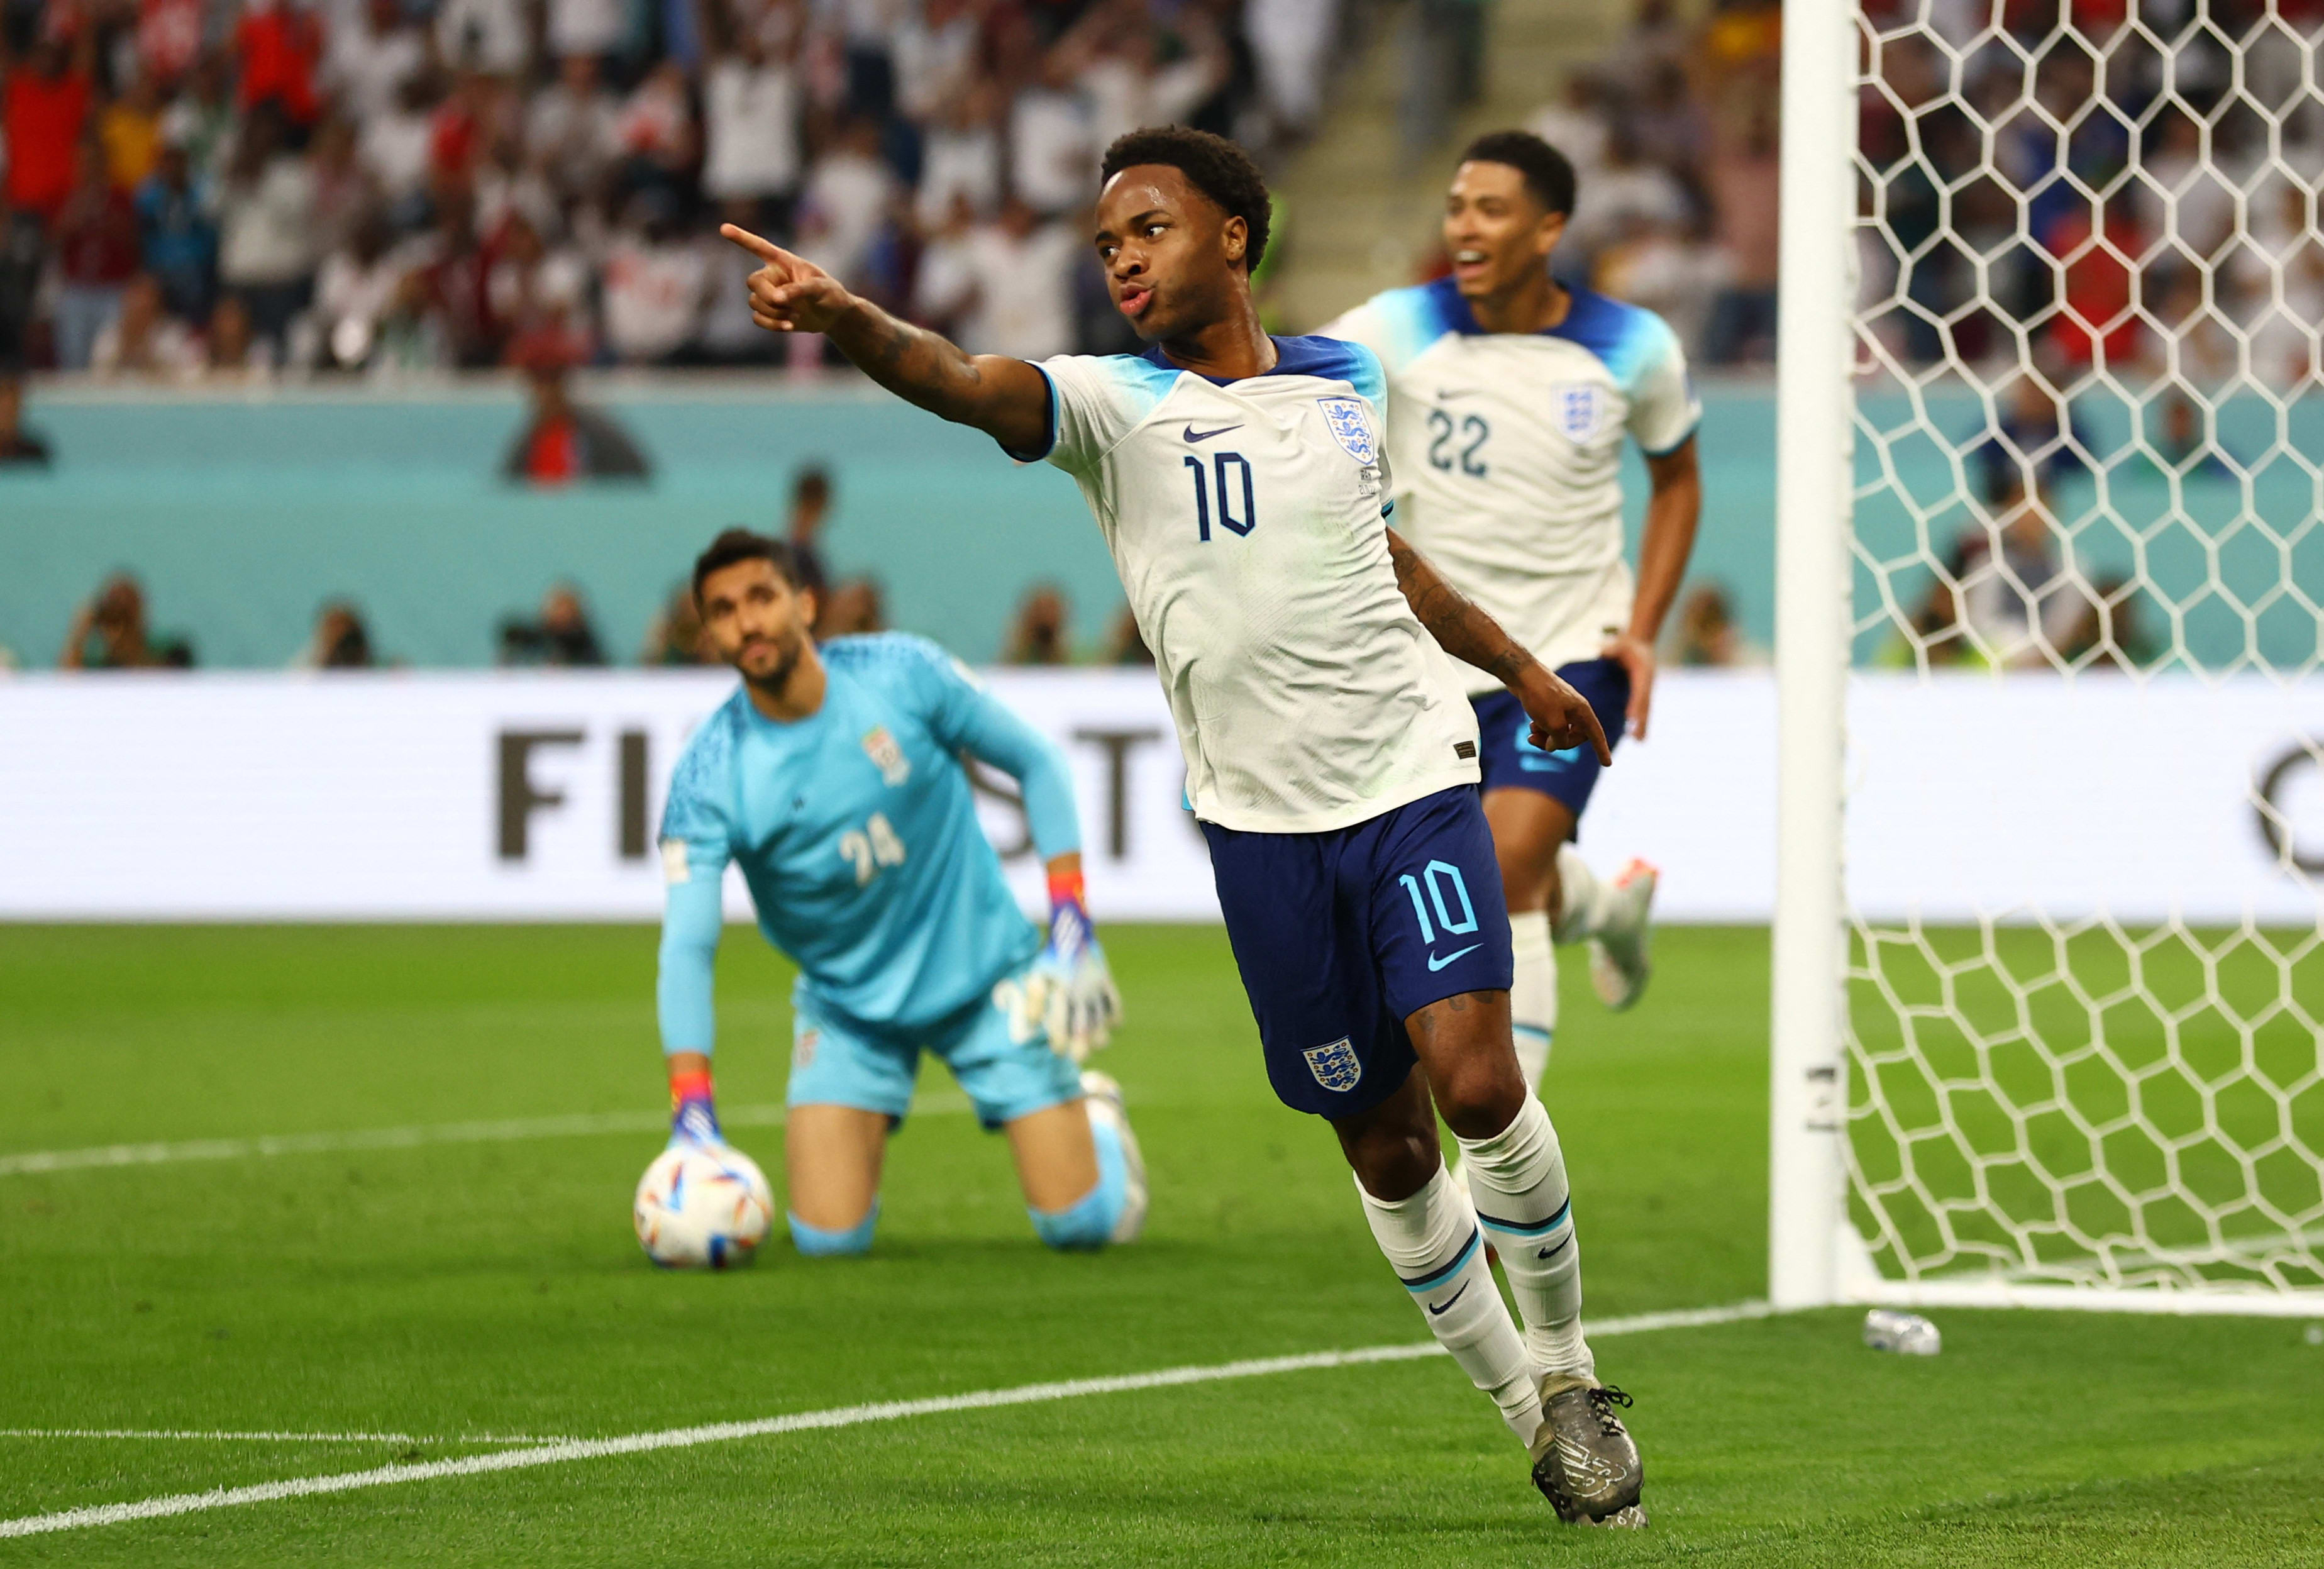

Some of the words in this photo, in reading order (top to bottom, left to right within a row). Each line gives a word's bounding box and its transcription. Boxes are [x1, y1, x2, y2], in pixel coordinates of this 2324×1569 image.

[1429, 409, 1491, 477] 22
[1184, 452, 1256, 542] 10
[840, 812, 905, 887] 24
[1399, 860, 1479, 945] 10
